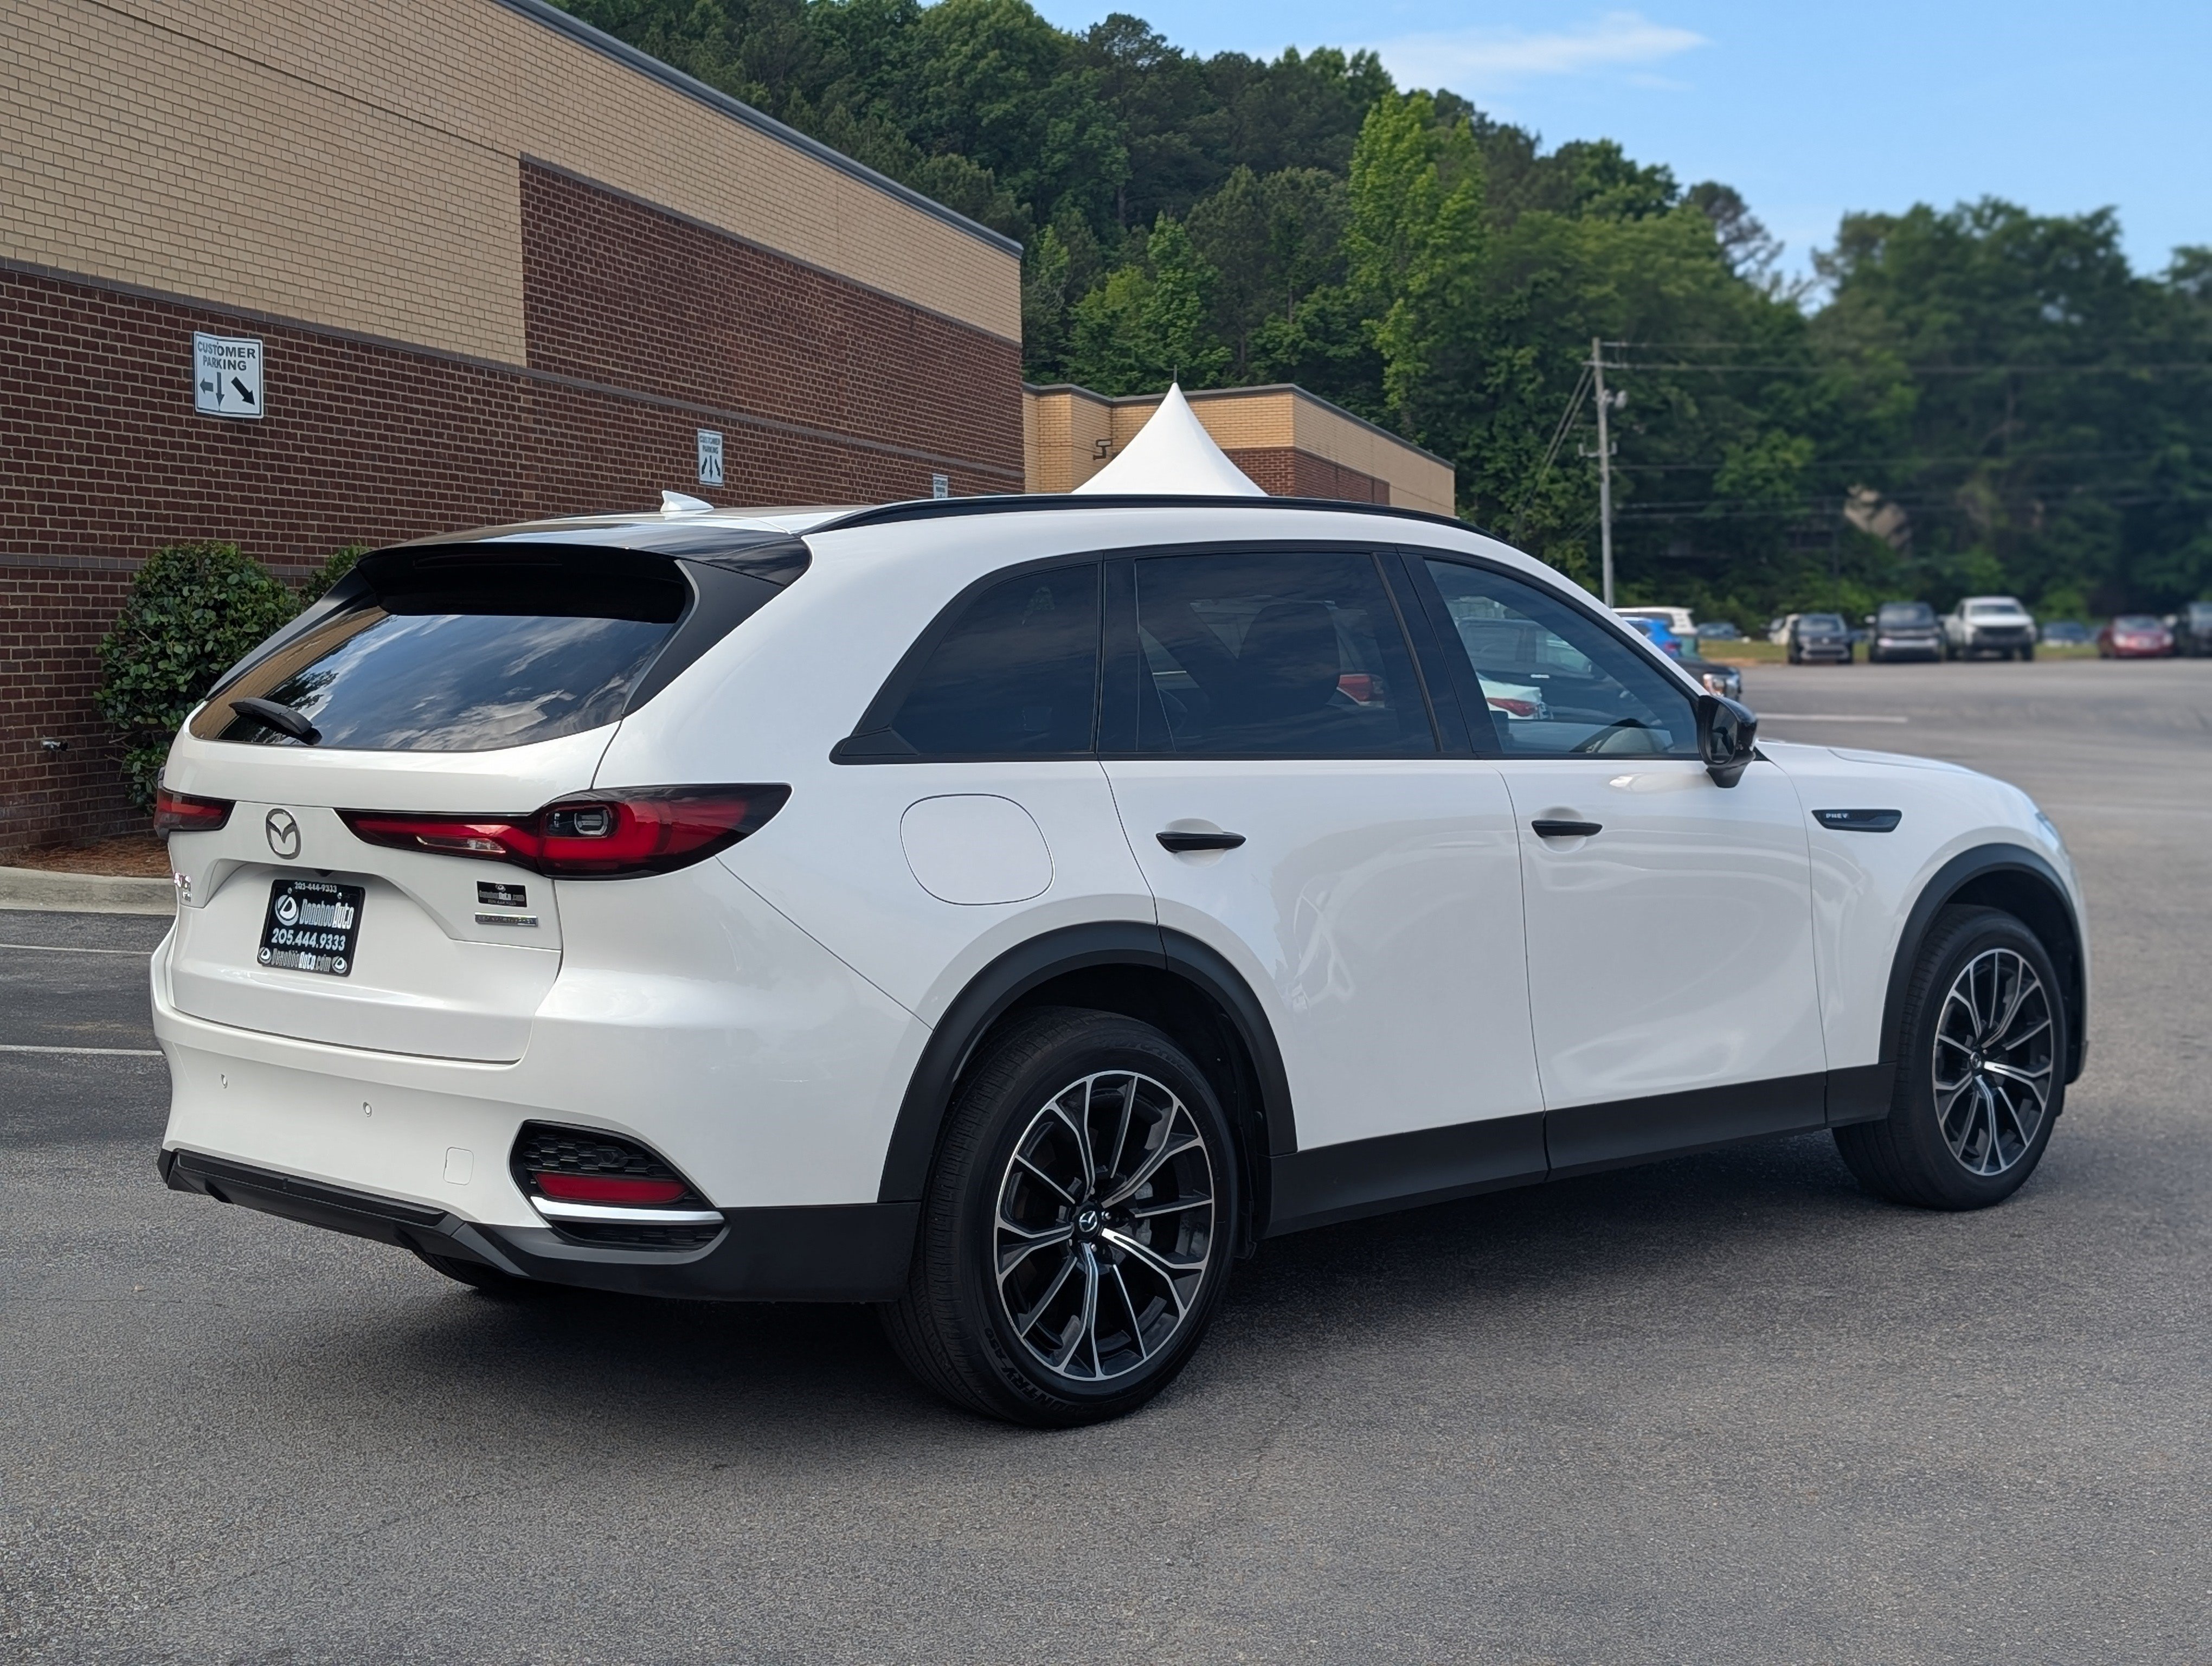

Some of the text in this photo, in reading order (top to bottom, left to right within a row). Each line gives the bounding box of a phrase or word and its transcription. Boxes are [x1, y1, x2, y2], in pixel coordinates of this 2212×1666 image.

[197, 341, 256, 358] CUSTOMER
[203, 355, 247, 371] PARKING
[271, 928, 346, 951] 205.444.9333
